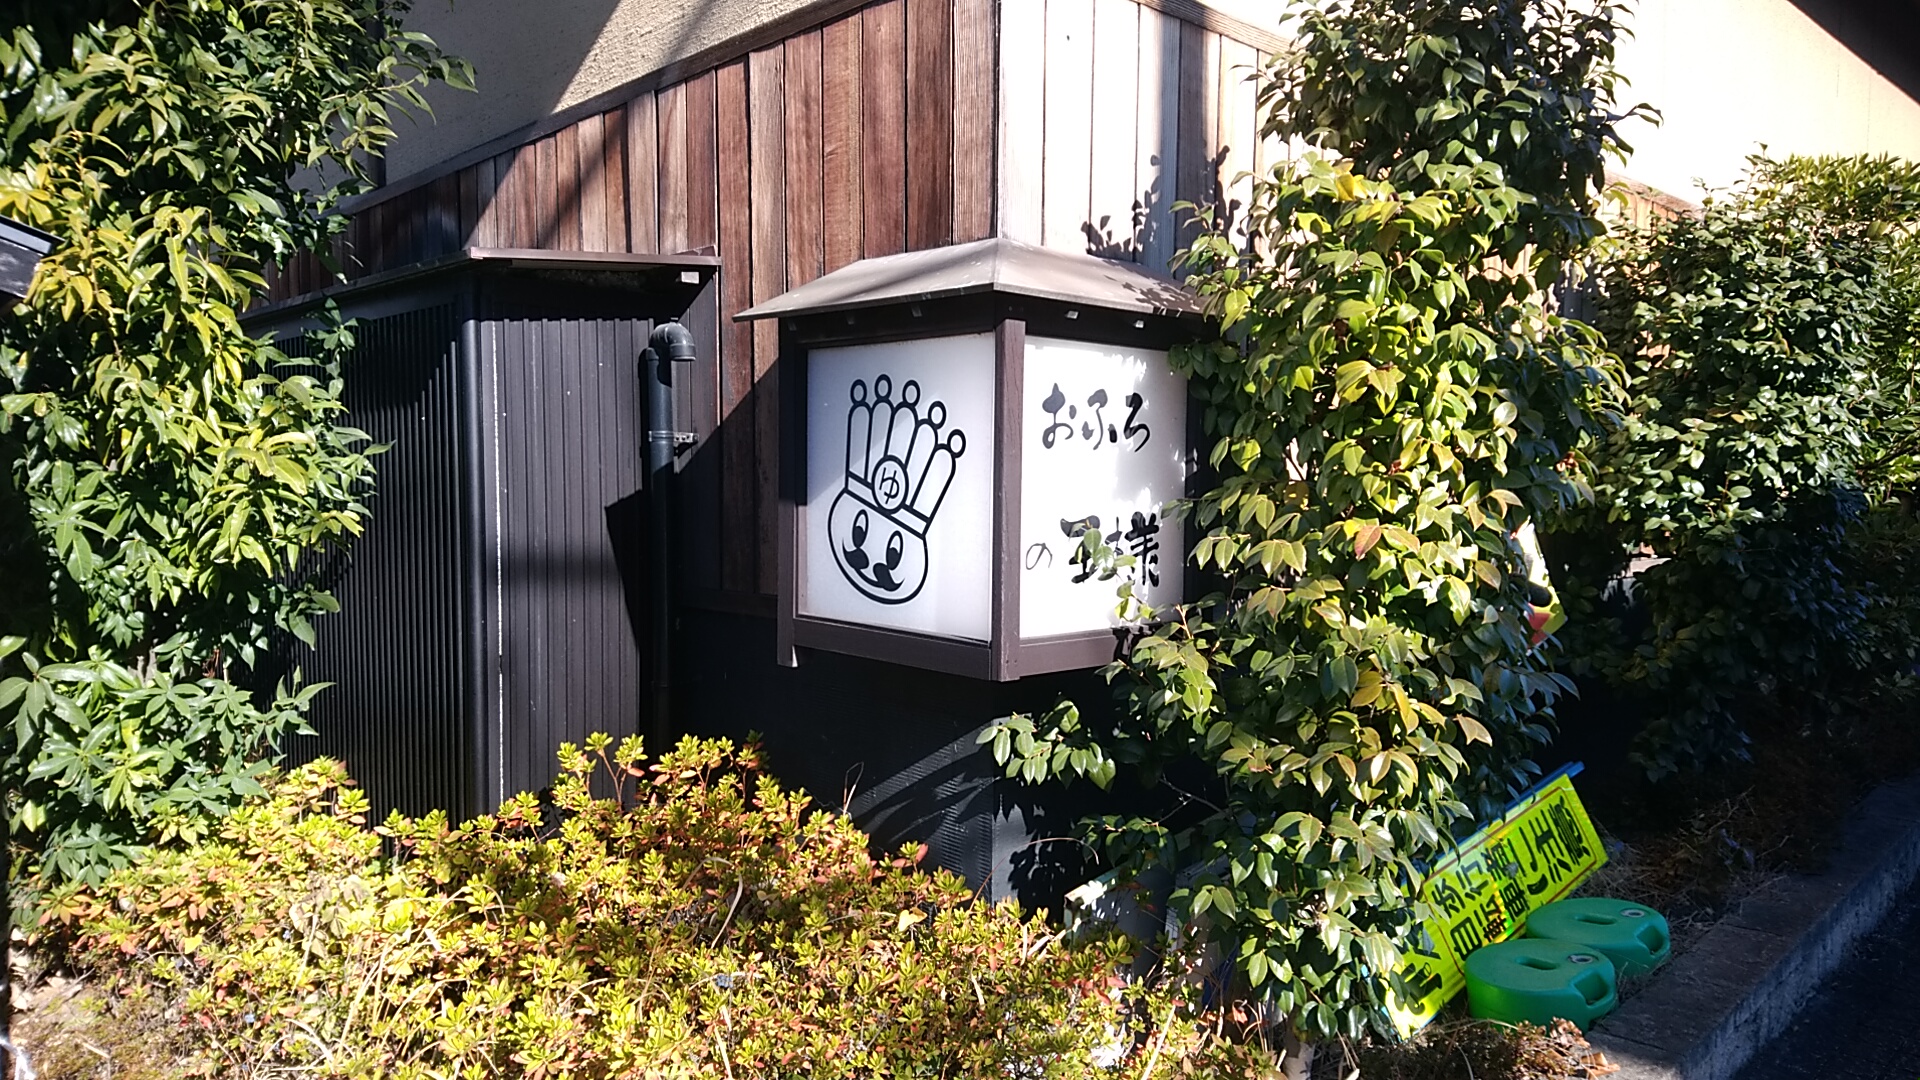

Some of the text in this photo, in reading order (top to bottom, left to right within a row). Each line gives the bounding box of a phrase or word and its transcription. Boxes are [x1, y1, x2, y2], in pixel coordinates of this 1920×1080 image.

[1042, 383, 1150, 452] おふろ
[1431, 842, 1513, 918] 歩行者
[1450, 877, 1530, 961] 自転車
